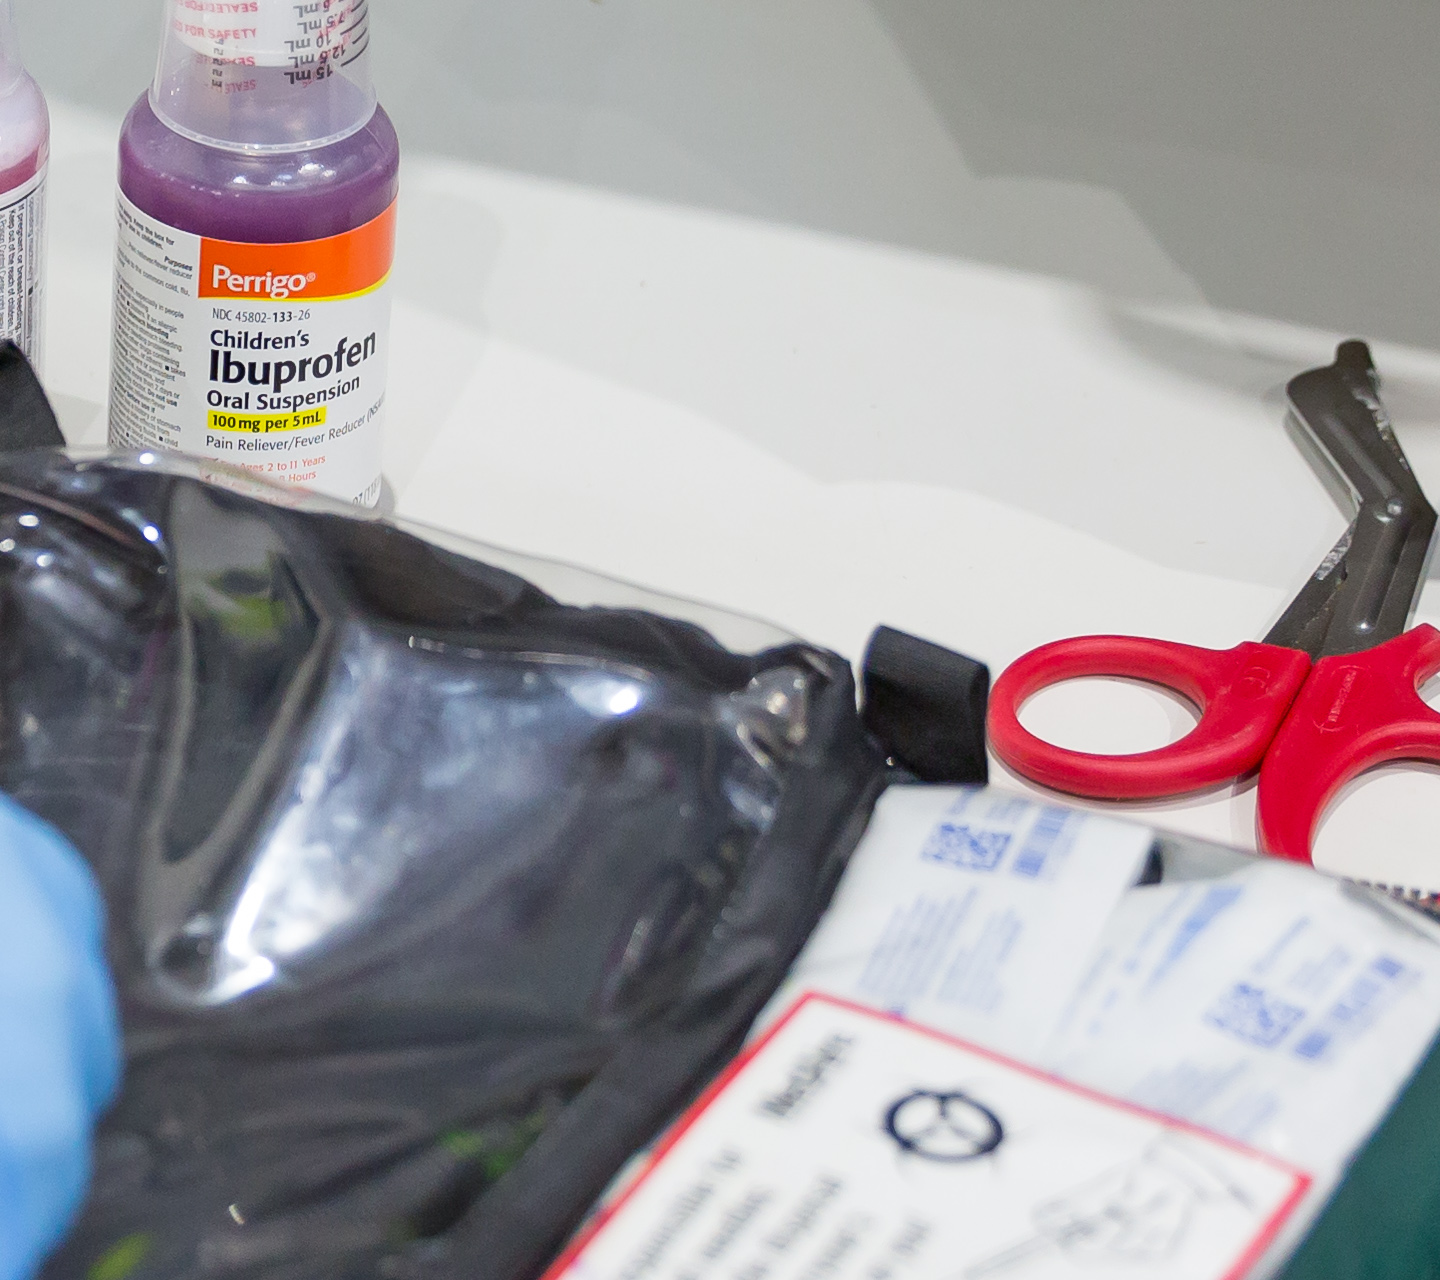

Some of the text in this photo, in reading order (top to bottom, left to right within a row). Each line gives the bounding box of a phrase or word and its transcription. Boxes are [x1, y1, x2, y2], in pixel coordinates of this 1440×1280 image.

[212, 264, 307, 299] Perrigo
[212, 308, 310, 323] NDC 45802-133-26
[210, 330, 310, 350] Children's
[209, 331, 376, 393] Ibuprofen
[207, 376, 360, 413] Oral Suspension
[206, 414, 365, 452] Pain Reliever/Fever Reducer
[213, 415, 236, 429] 100
[239, 418, 260, 433] mg
[265, 417, 288, 433] per
